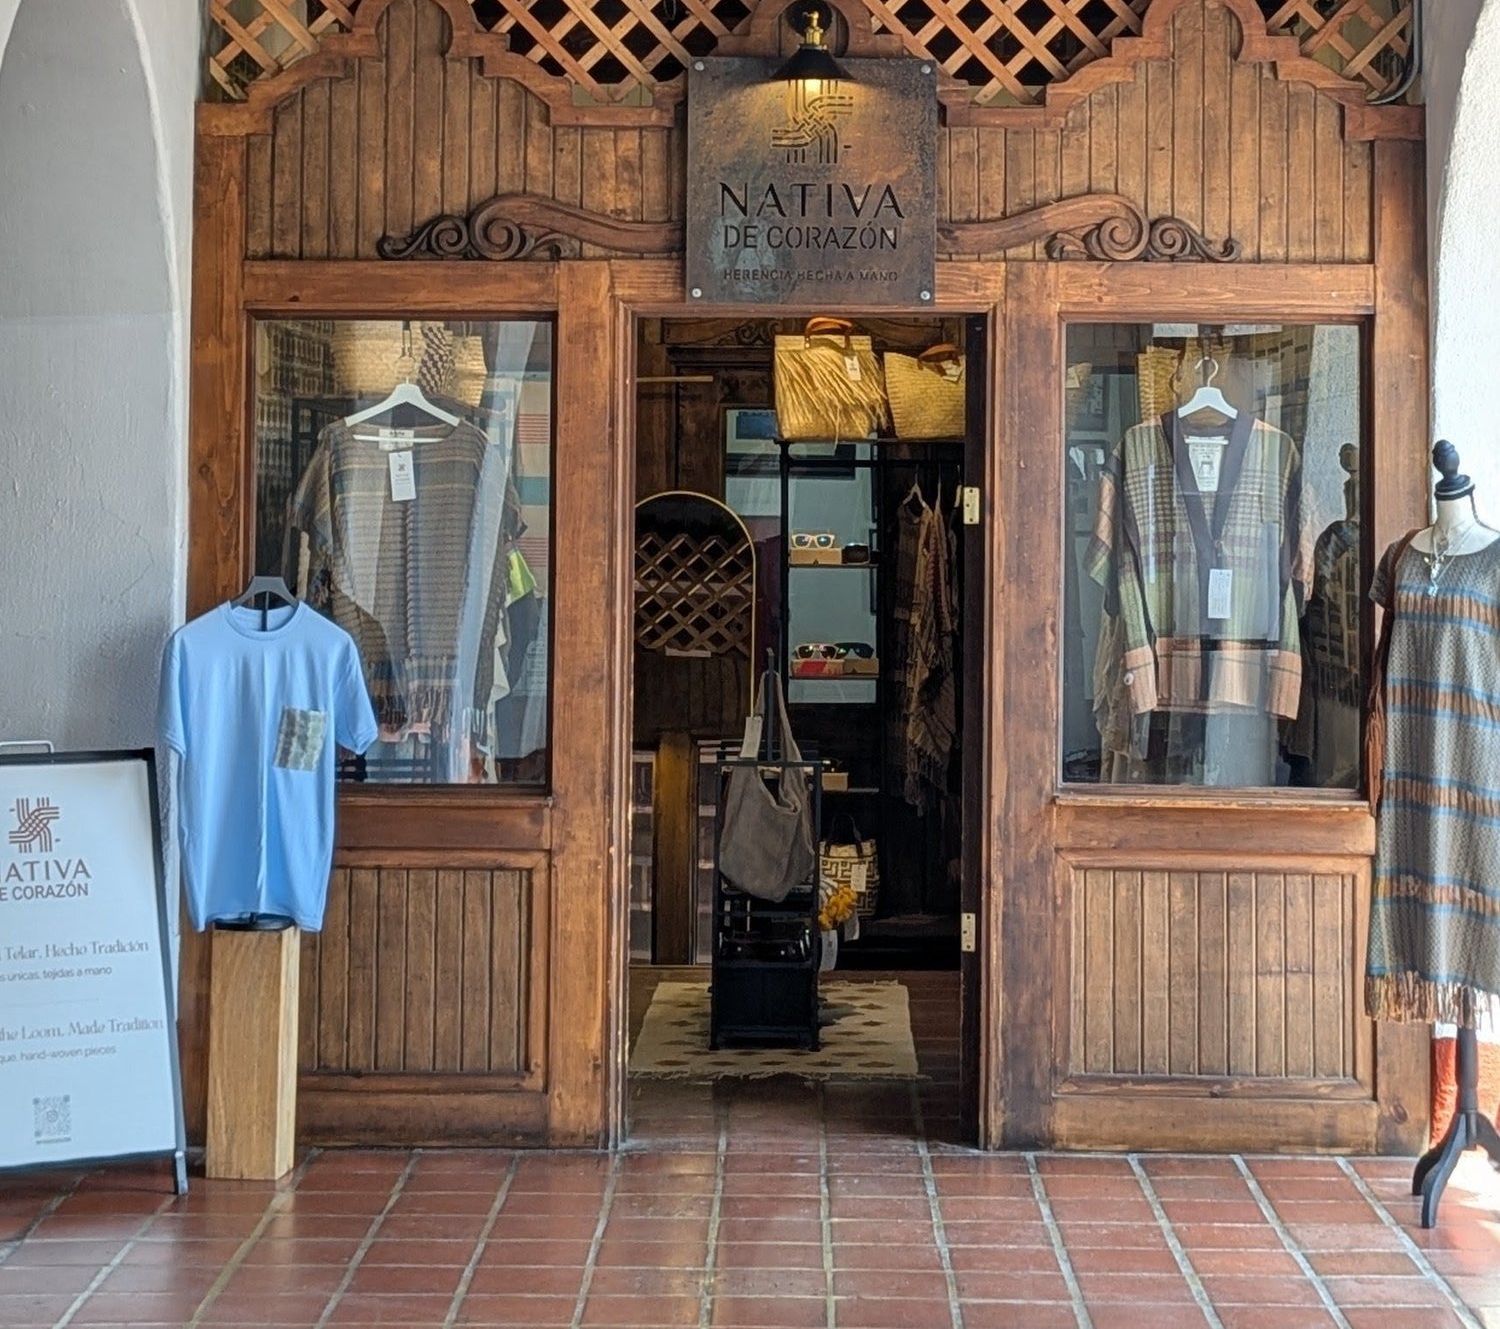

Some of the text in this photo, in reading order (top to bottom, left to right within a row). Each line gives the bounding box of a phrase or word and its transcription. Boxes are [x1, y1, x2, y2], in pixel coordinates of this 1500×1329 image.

[719, 182, 905, 219] NATIVA
[723, 221, 898, 250] DE CORAZÓN
[723, 269, 898, 282] HERENCIA HECHA A MANO
[0, 858, 91, 883] ATIVA
[12, 881, 89, 901] CORAZÓN
[46, 941, 87, 958] Hecho
[89, 939, 149, 954] Tradición
[43, 967, 74, 981] tejidas
[77, 968, 83, 977] a
[84, 966, 112, 976] mano
[68, 1019, 105, 1035] Made
[108, 1016, 163, 1032] Tradition
[84, 1045, 117, 1058] pieces
